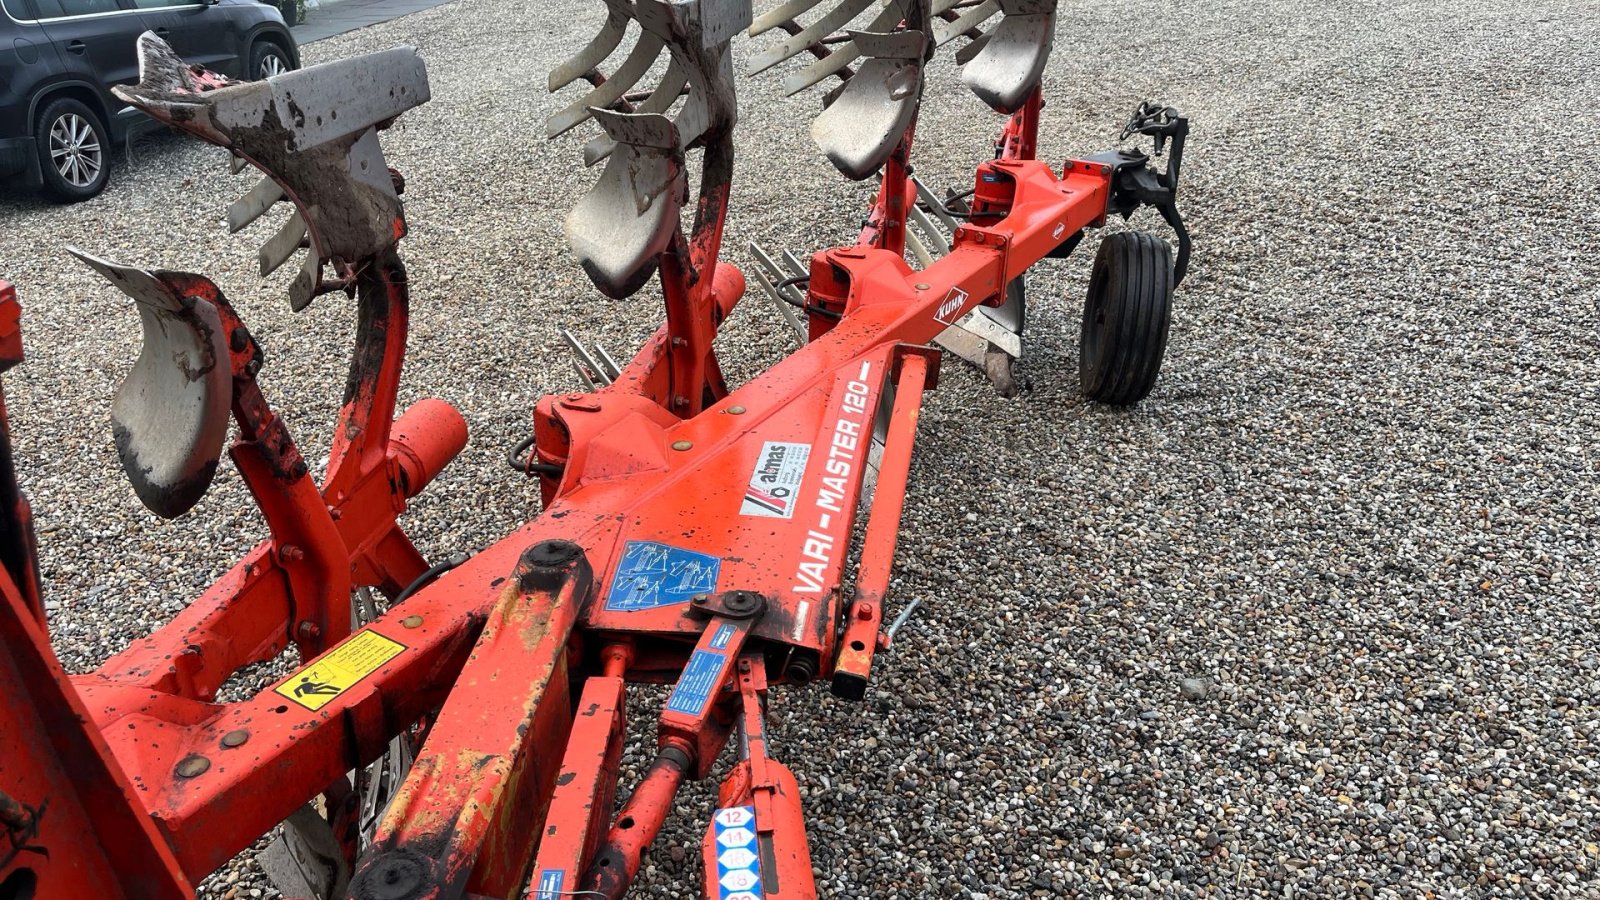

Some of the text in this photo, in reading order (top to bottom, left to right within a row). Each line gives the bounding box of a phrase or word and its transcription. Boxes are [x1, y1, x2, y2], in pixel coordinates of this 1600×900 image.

[939, 293, 964, 320] KUHN
[758, 445, 786, 483] almas
[792, 530, 834, 593] VARI
[816, 419, 860, 512] MASTER
[841, 380, 869, 414] 120
[725, 810, 742, 823] 12
[726, 831, 744, 844] 14
